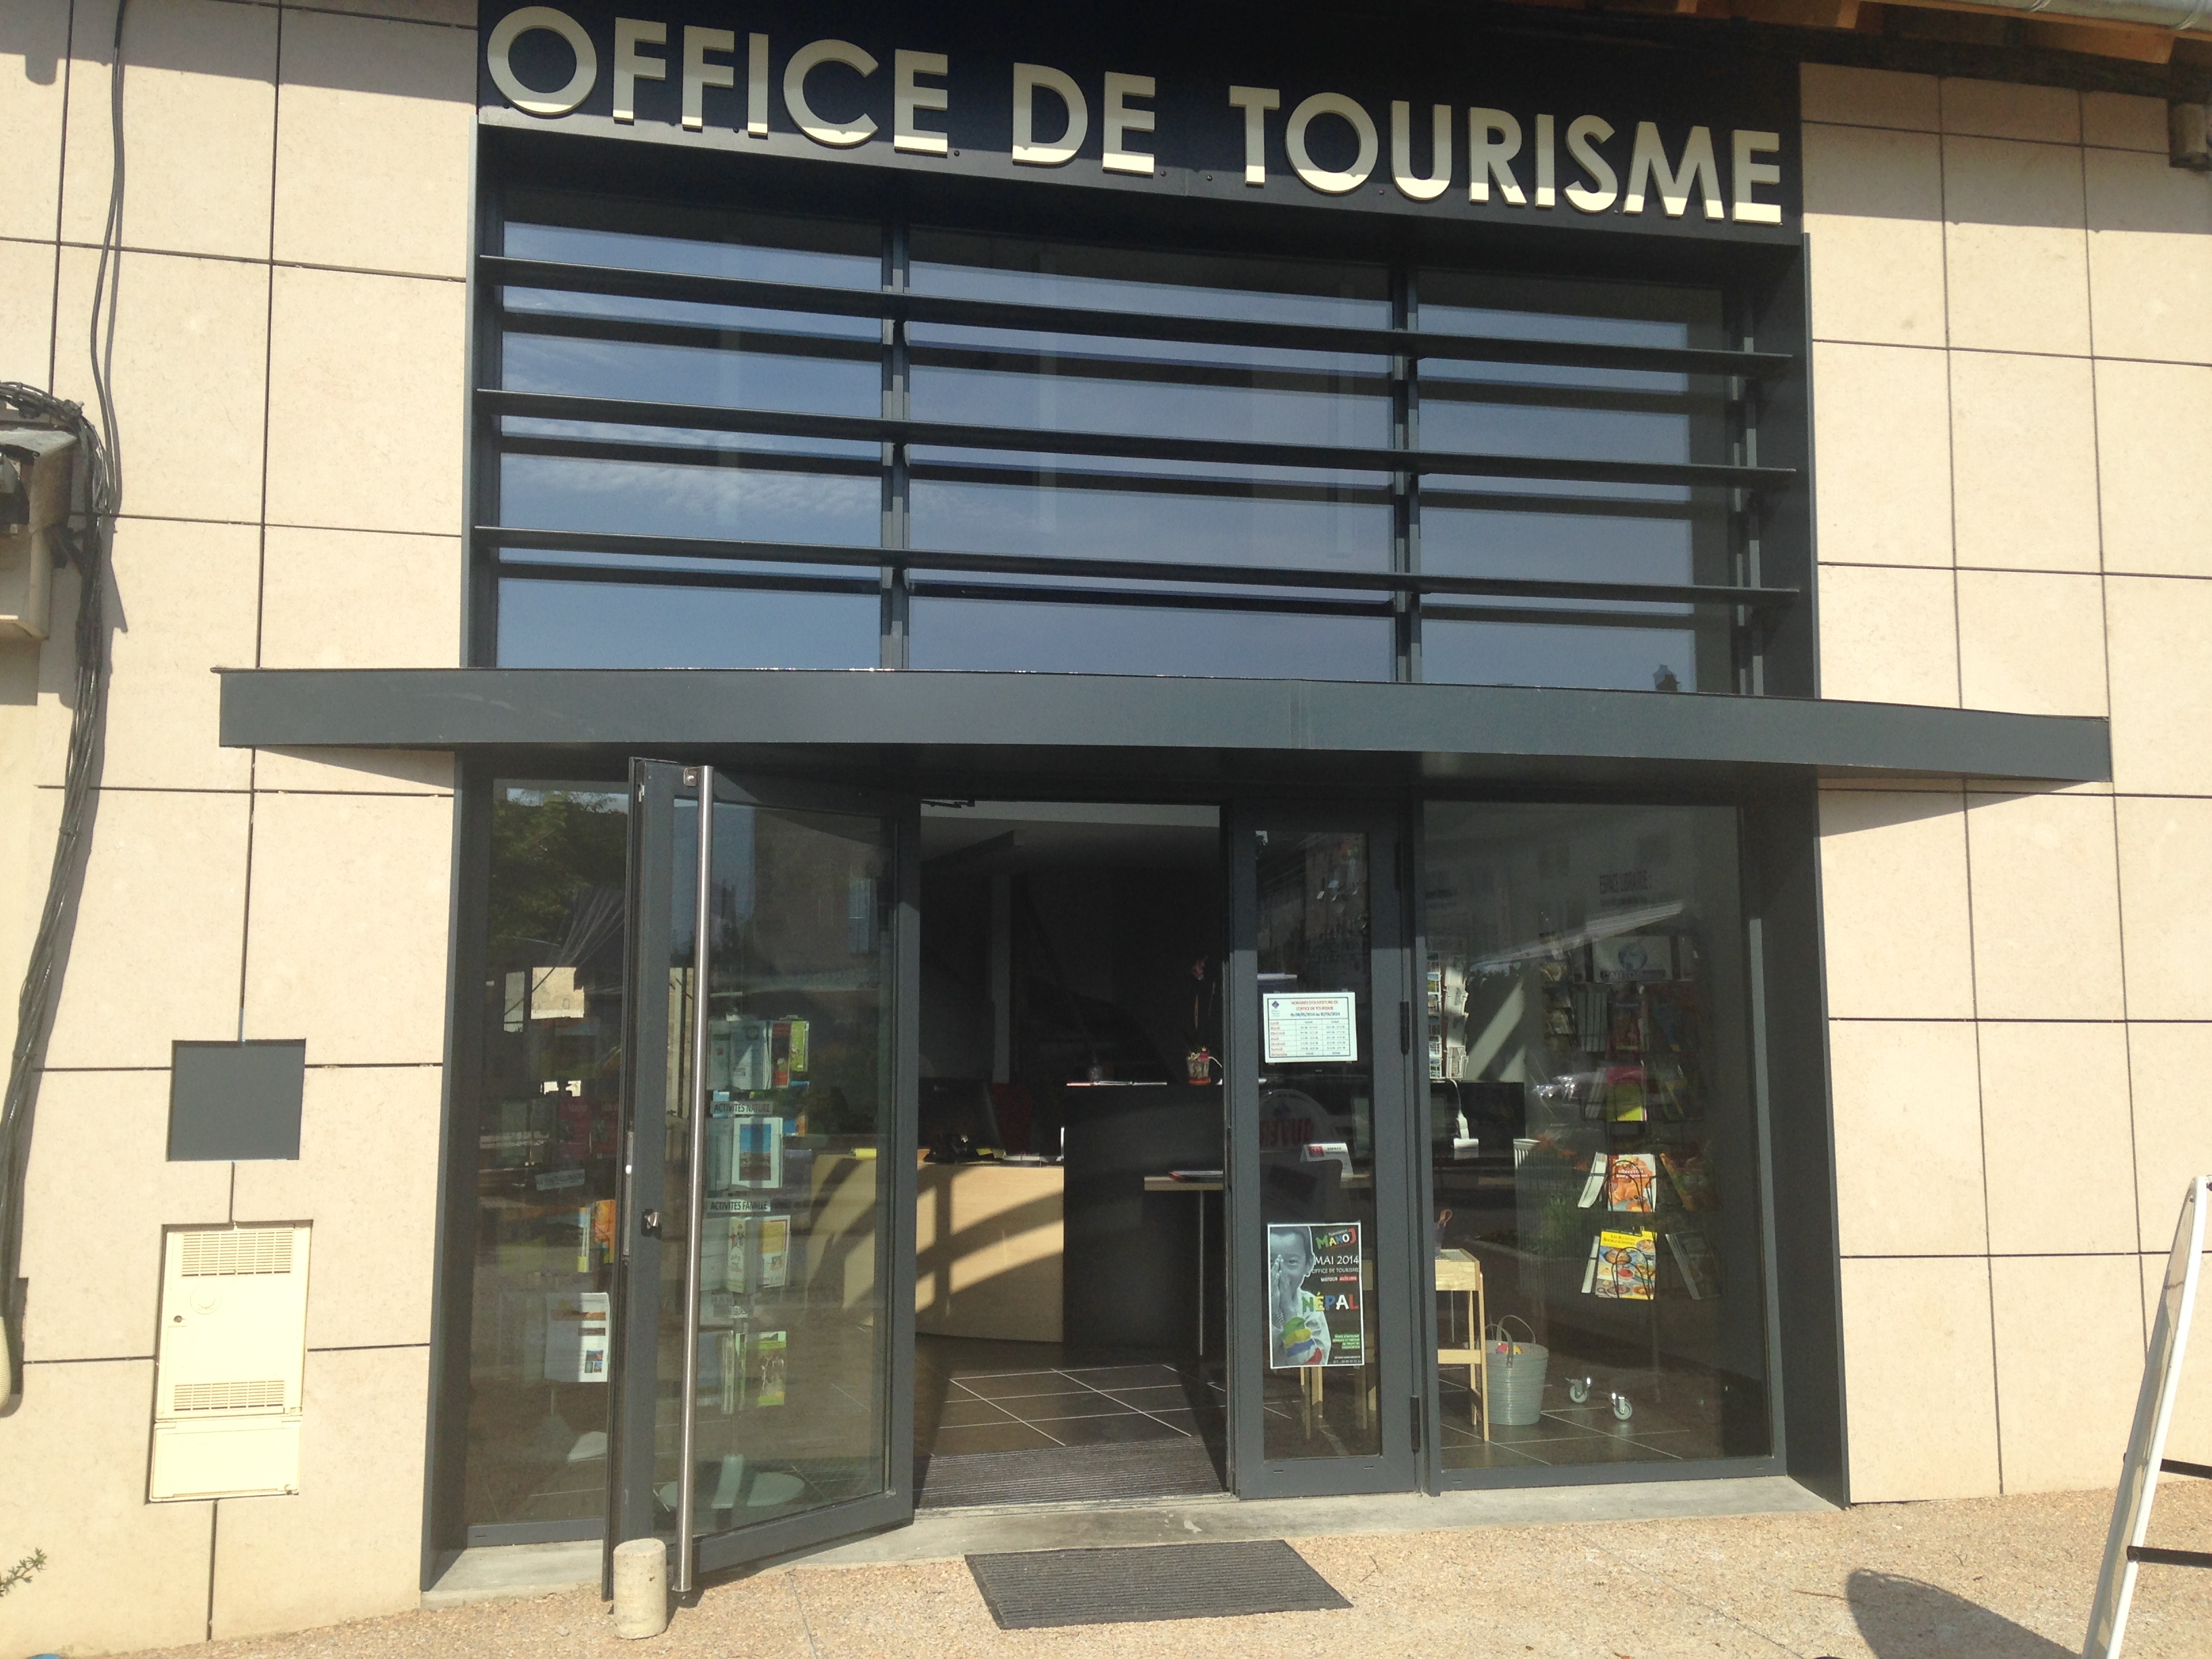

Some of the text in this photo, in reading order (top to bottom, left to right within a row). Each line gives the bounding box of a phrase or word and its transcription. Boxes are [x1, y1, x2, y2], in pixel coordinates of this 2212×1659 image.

[487, 5, 1782, 224] OFFICE DE TOURISME
[742, 1198, 767, 1210] FAMILLE
[1315, 1228, 1357, 1250] MANOJ
[1315, 1254, 1359, 1265] MAI 2014
[1301, 1291, 1359, 1312] NÉPAL
